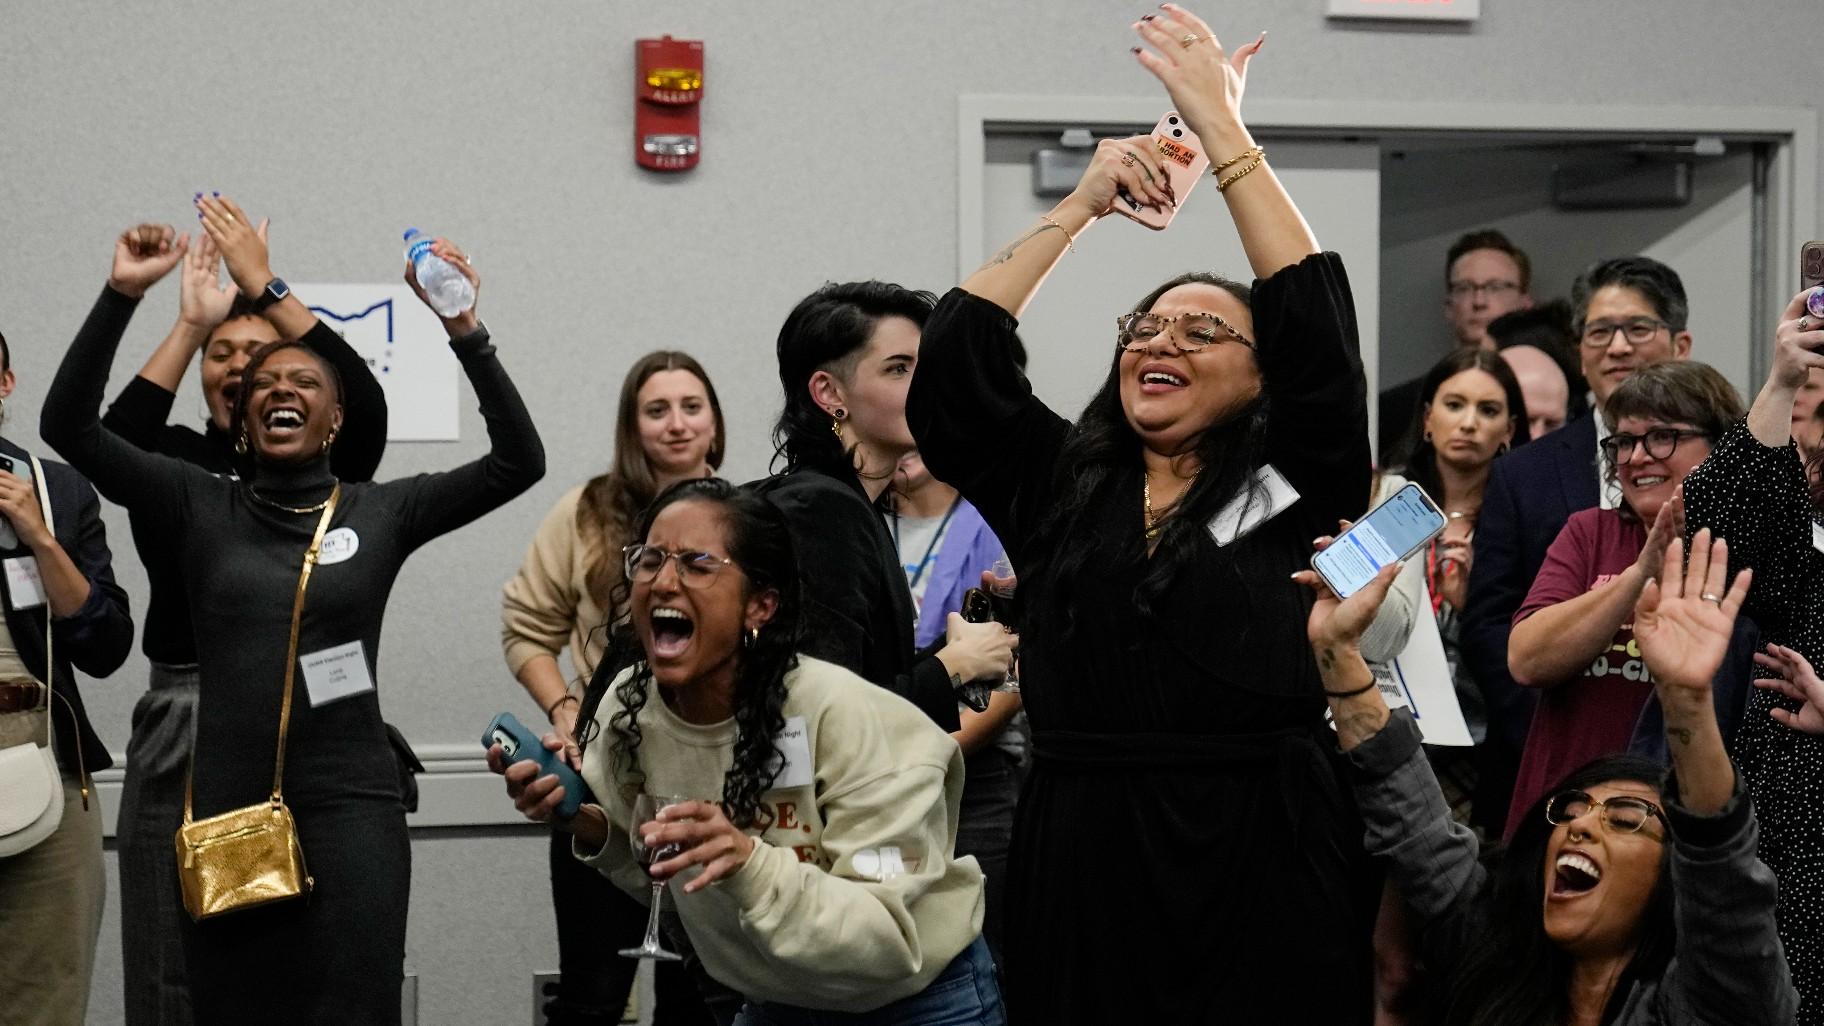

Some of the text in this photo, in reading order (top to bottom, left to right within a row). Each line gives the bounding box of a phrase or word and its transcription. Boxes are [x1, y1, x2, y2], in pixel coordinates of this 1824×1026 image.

[1157, 146, 1191, 166] BORTION
[1164, 142, 1180, 153] HAD
[1183, 151, 1195, 160] AN
[785, 730, 801, 739] Night
